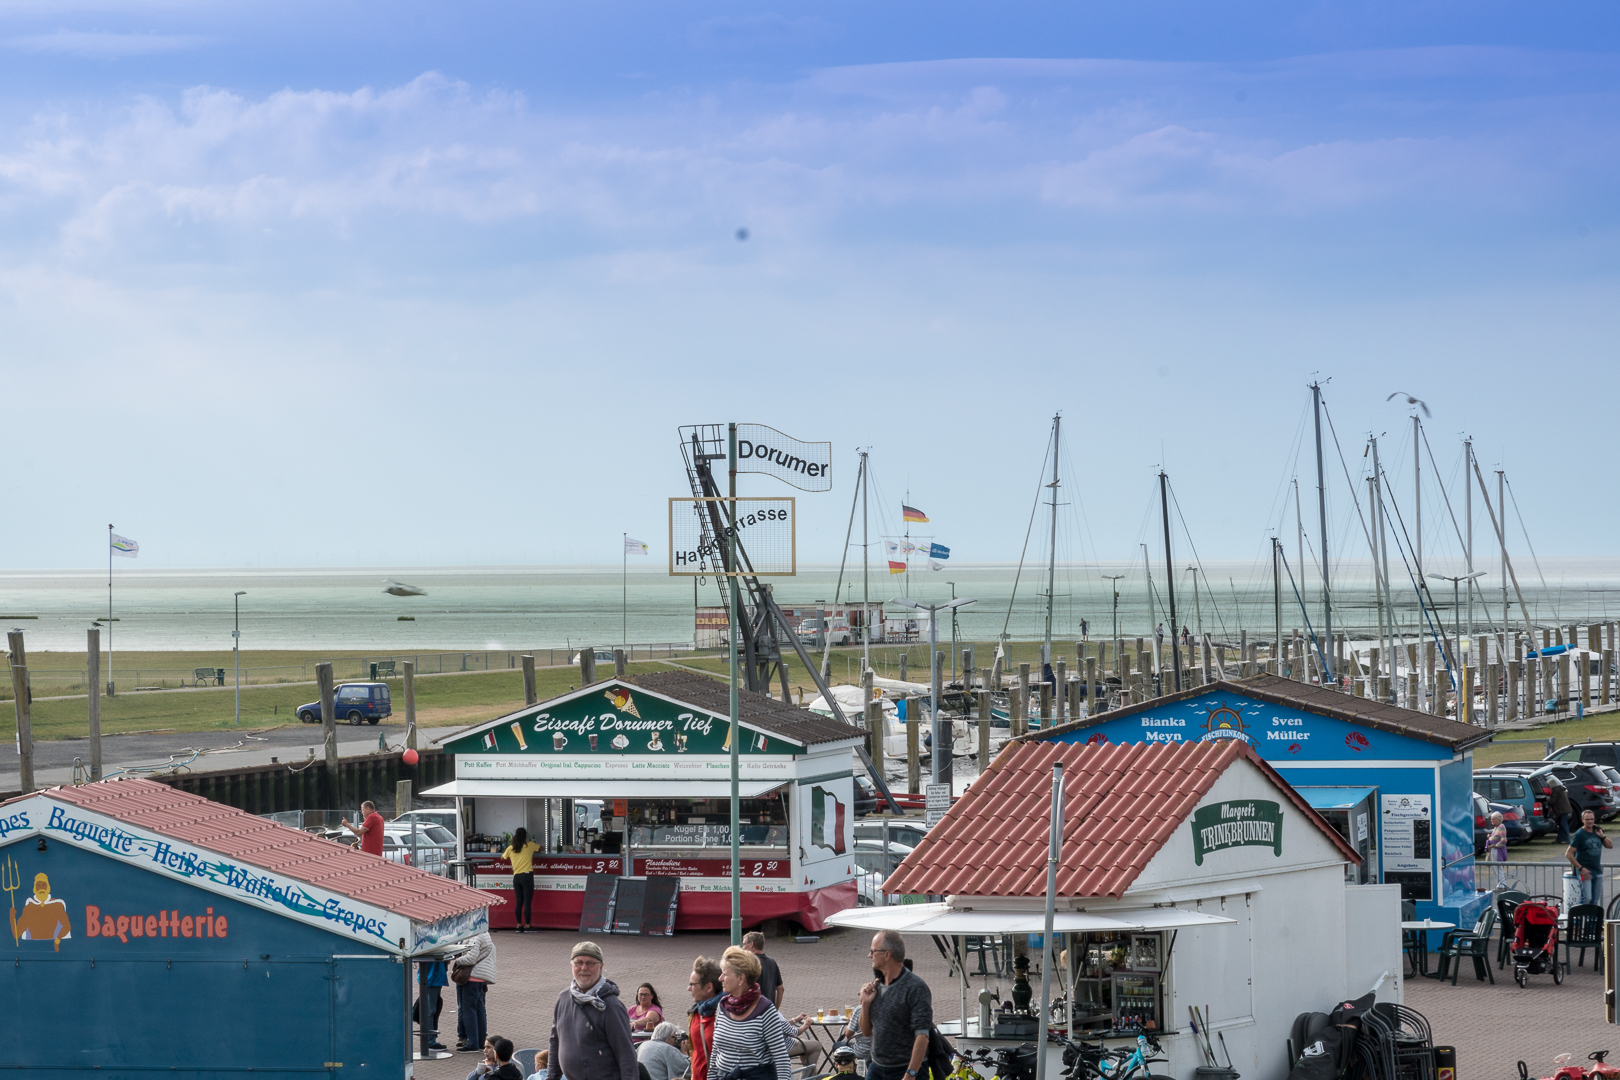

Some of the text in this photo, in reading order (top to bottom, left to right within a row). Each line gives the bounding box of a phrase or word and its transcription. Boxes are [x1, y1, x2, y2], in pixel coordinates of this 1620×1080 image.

[738, 440, 828, 477] Dorumer
[676, 509, 787, 566] Hafenterrasse
[696, 617, 730, 625] DLRG
[534, 713, 713, 735] Eiscafé Dorumer Tief
[1141, 717, 1186, 727] Bianka
[1272, 716, 1303, 726] Sven
[1146, 731, 1182, 743] Meyn
[1201, 729, 1250, 743] FISCHFEINKOST
[1267, 730, 1310, 740] Müller
[1221, 803, 1256, 820] Margret's
[0, 811, 30, 838] pes
[674, 825, 696, 834] Kugel
[712, 825, 729, 834] 1,00
[665, 834, 693, 842] Portion
[721, 834, 732, 844] 1,0
[1200, 820, 1275, 850] TRINKBRUNNEN
[645, 859, 681, 867] Flaschenbiere
[47, 806, 133, 852] Baguette
[151, 840, 207, 877] Heiße
[226, 864, 302, 910] Waffeln
[323, 897, 388, 937] Crepes
[85, 904, 228, 944] Baguetterie
